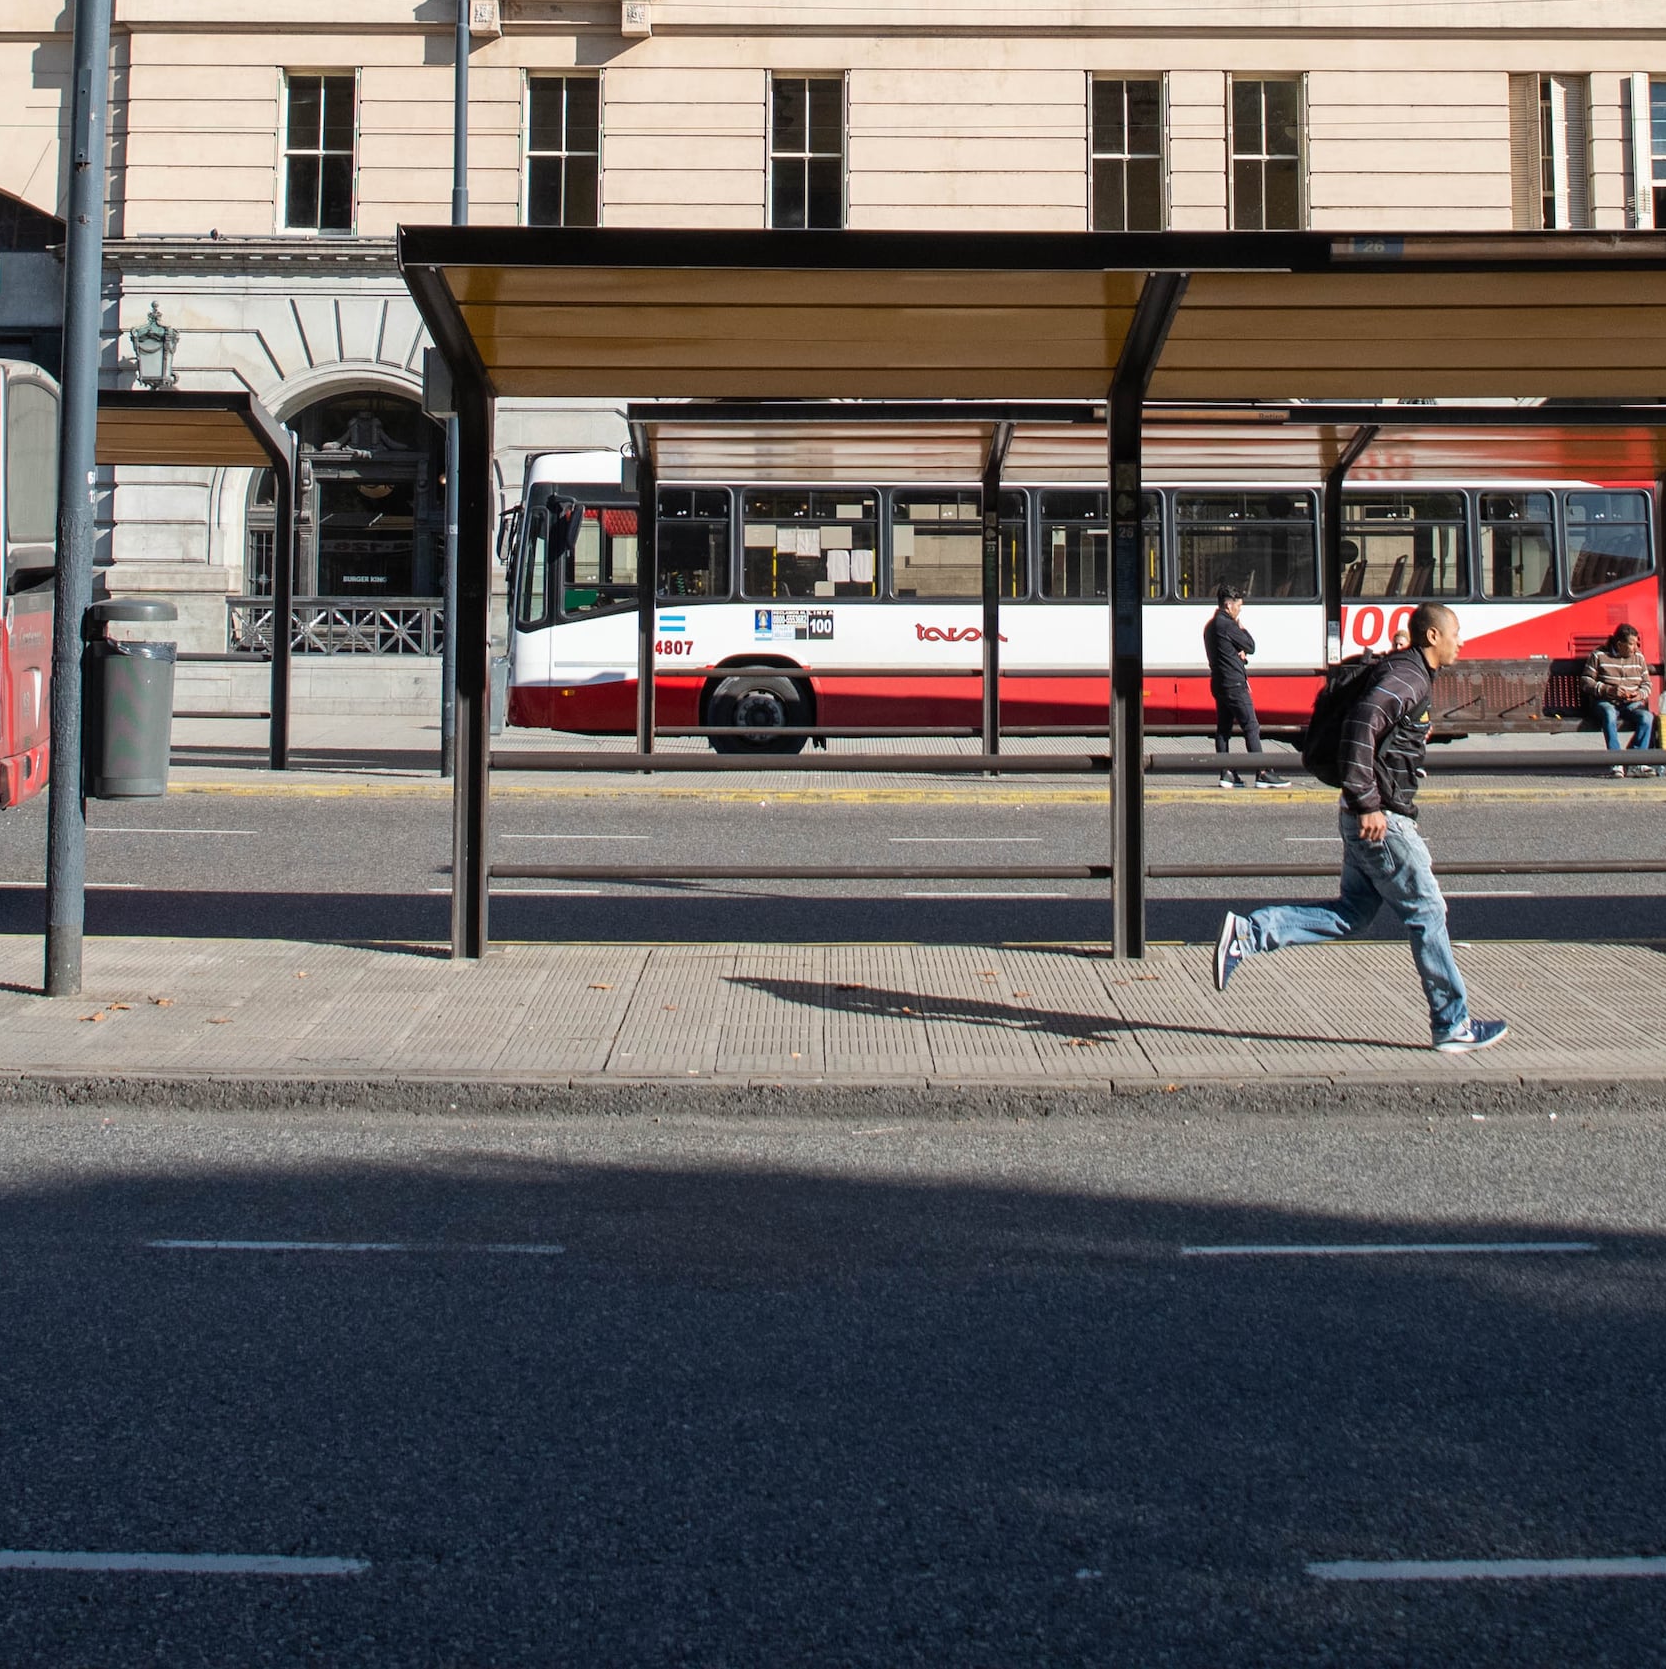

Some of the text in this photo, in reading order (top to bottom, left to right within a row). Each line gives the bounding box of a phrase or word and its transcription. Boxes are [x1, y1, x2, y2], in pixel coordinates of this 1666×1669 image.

[342, 575, 388, 583] BURGER KING
[810, 618, 832, 634] 100
[655, 640, 694, 655] 4807
